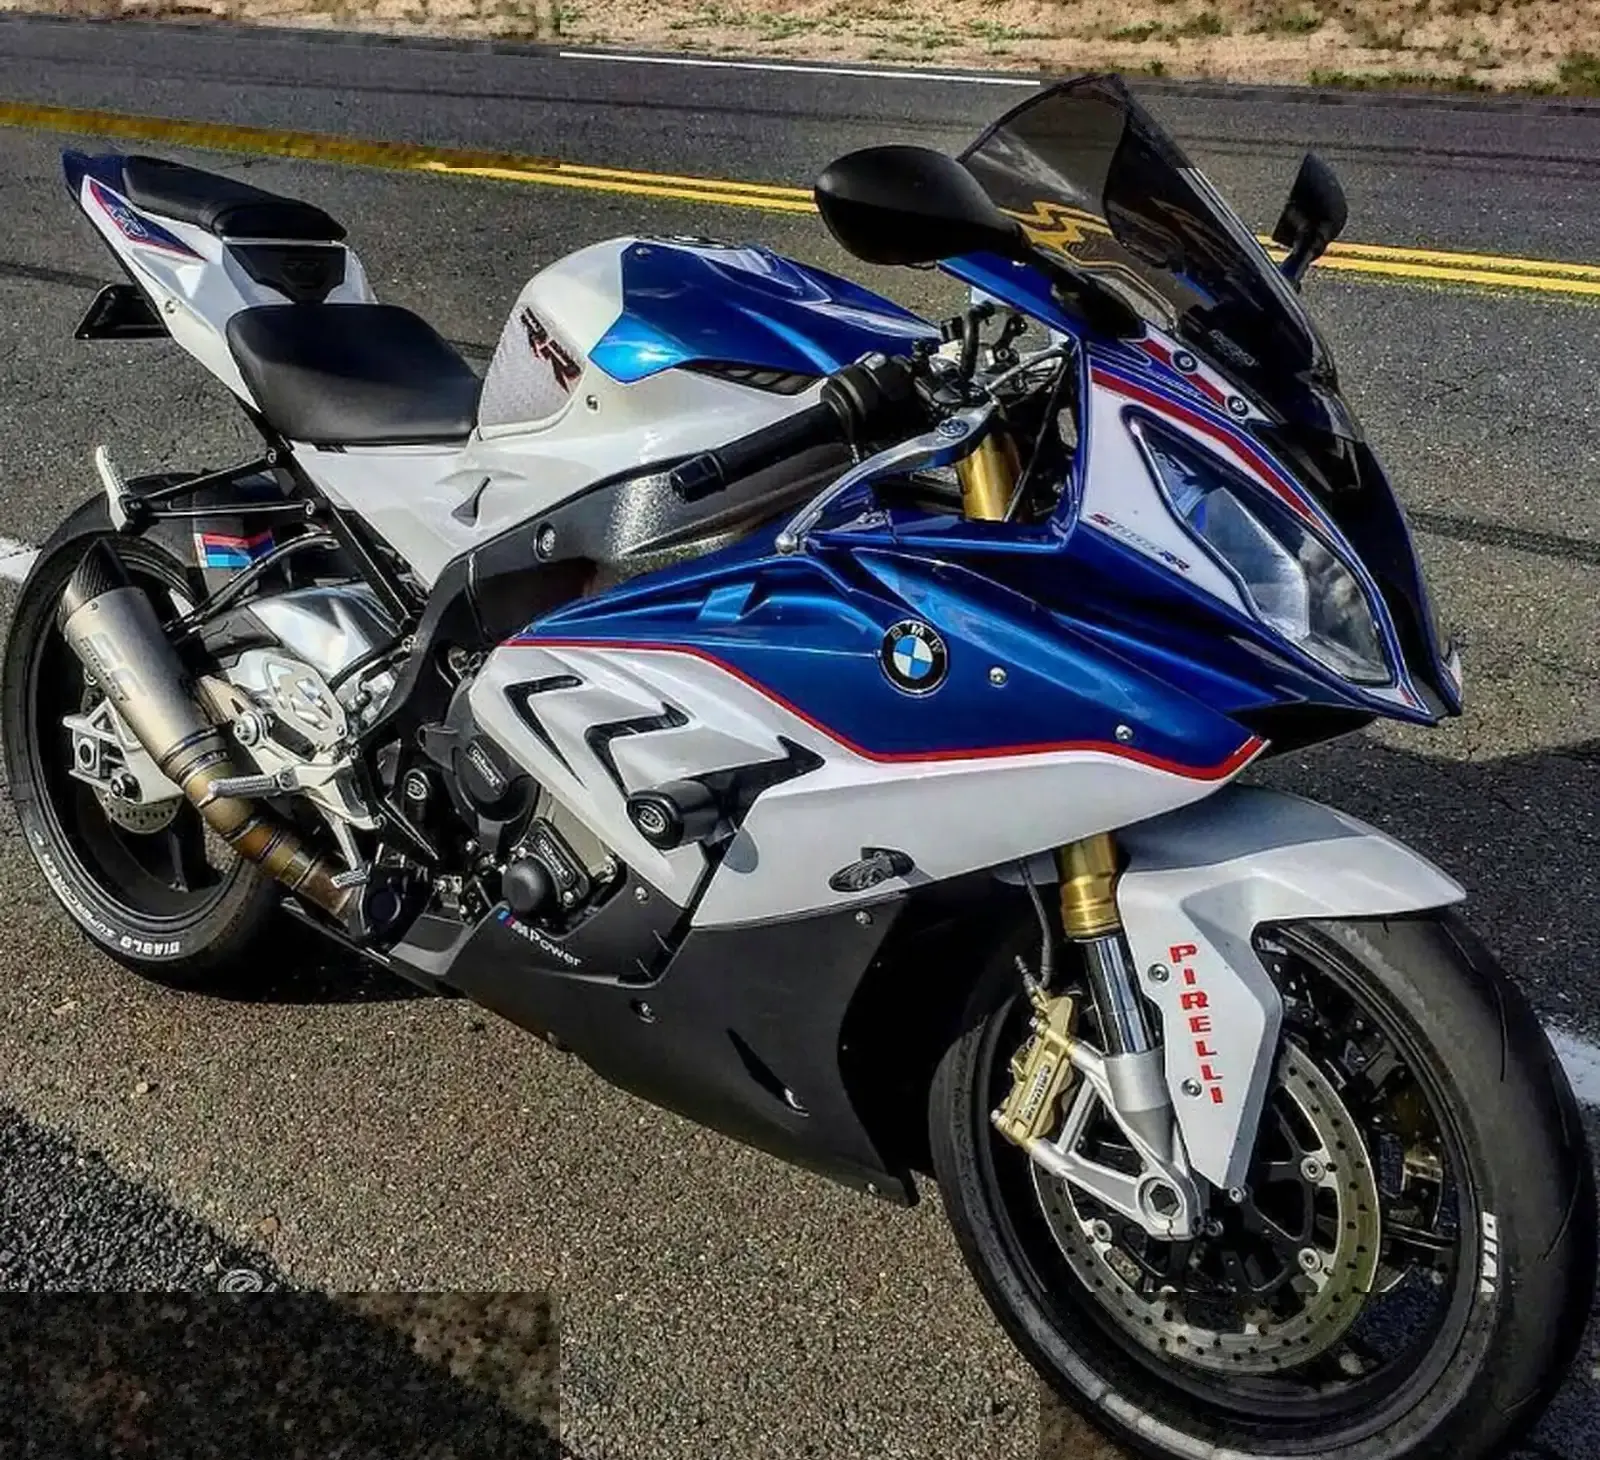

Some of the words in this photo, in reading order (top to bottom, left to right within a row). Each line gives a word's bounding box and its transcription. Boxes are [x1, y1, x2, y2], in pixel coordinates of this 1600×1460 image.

[890, 624, 944, 654] BMW
[119, 935, 181, 956] DIABLO
[1169, 943, 1223, 1104] PIRELLI
